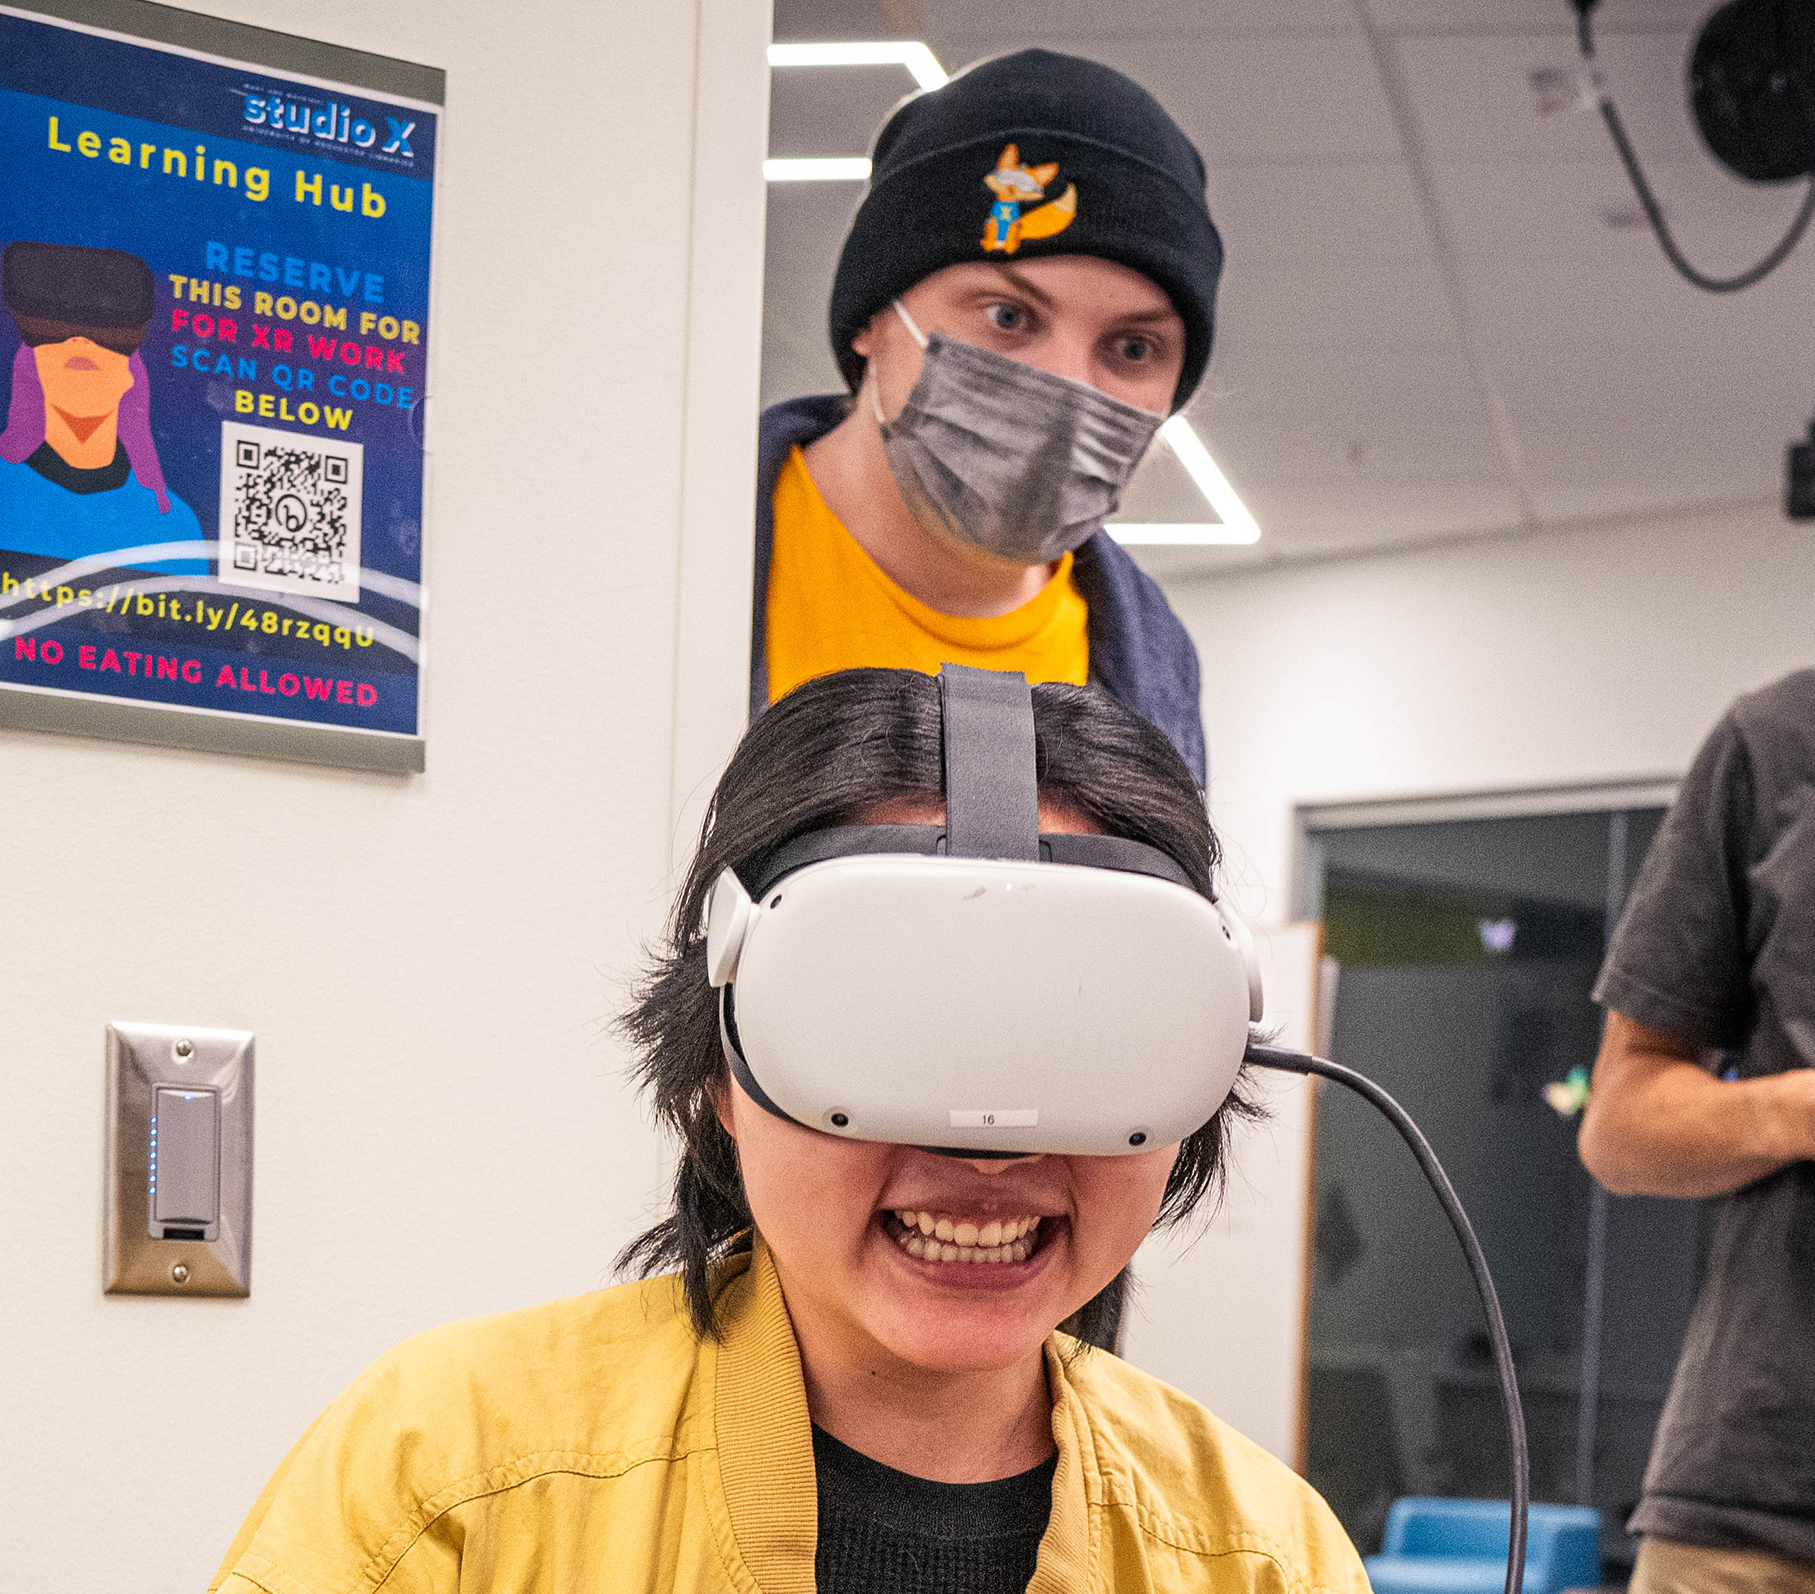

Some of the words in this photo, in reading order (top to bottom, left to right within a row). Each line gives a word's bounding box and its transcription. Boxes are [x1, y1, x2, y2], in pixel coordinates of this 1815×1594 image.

[243, 94, 376, 148] studio
[382, 116, 416, 158] X
[48, 116, 270, 201] Learning
[295, 170, 386, 218] Hub
[205, 241, 385, 303] RESERVE
[169, 274, 242, 310] THIS
[254, 291, 348, 330] ROOM
[359, 311, 421, 345] FOR
[172, 309, 238, 343] FOR
[252, 324, 293, 353] XR
[307, 334, 405, 374] WORK
[171, 345, 258, 381] SCAN
[272, 364, 315, 392] QR
[328, 374, 413, 410] CODE
[235, 389, 354, 431] BELOW
[15, 636, 64, 665] NO
[78, 645, 202, 683] EATING
[215, 665, 378, 706] ALLOWED
[982, 1114, 995, 1126] 16
